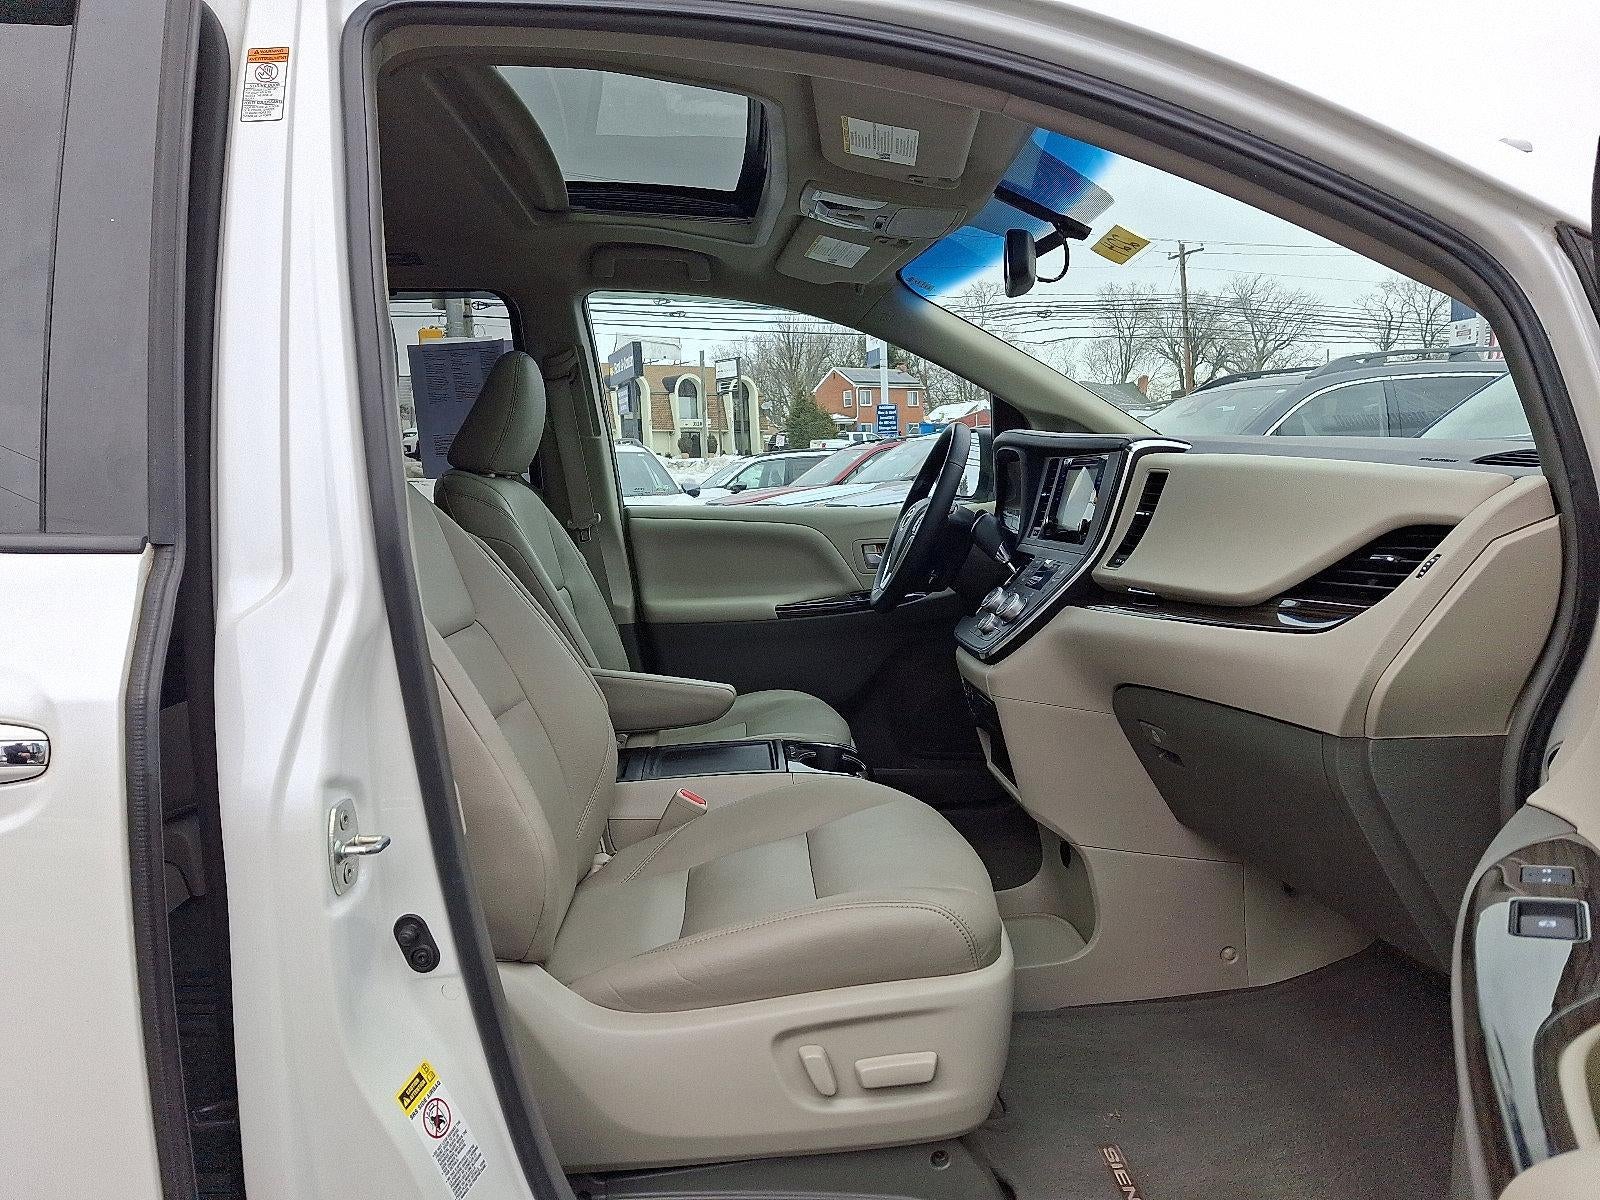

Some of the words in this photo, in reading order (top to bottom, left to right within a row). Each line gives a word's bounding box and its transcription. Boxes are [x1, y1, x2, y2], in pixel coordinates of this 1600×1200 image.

[406, 1077, 420, 1095] CAUTION
[409, 1109, 419, 1120] SRS
[417, 1098, 428, 1110] SIDE
[426, 1080, 441, 1099] AIRBAG
